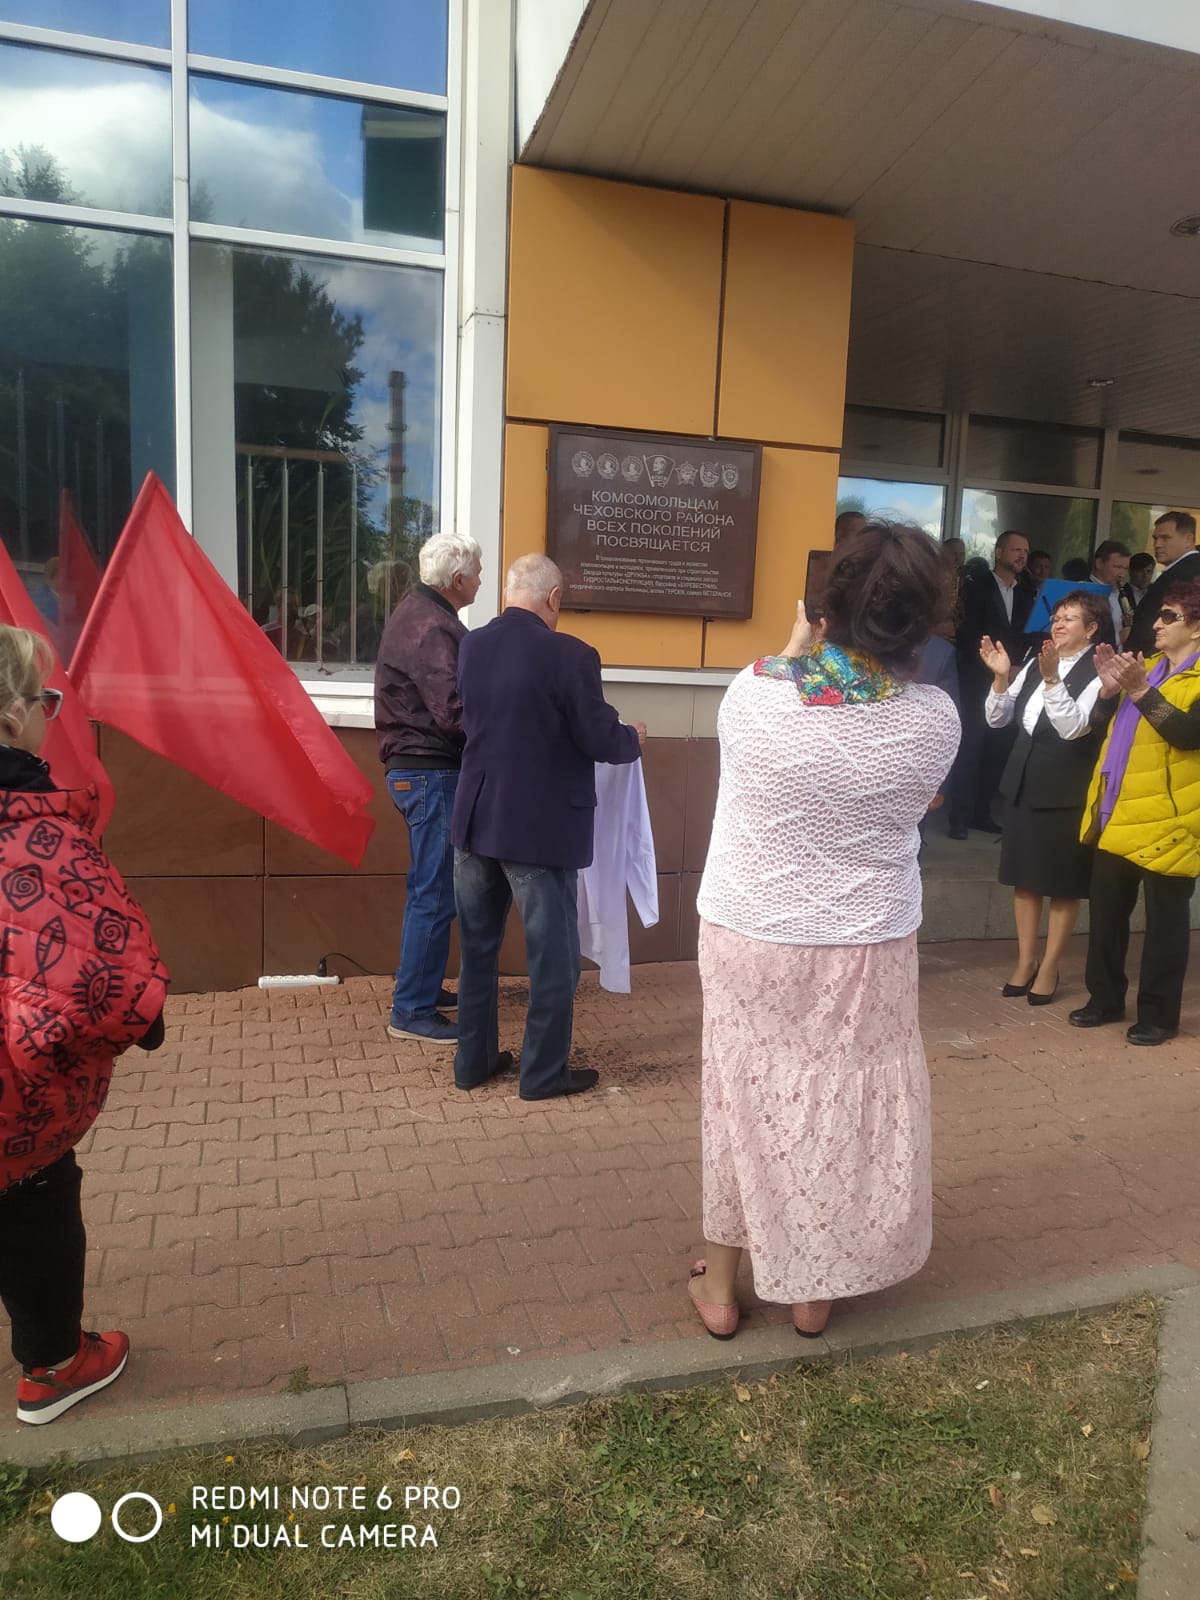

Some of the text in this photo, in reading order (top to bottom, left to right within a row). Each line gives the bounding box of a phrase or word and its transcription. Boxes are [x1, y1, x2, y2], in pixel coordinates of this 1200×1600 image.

[591, 490, 719, 511] КОМСОМОЛЬЦАМ
[573, 503, 735, 526] ЧЕХОВСКОГО РАЙОНА
[587, 519, 721, 539] ВСЕХ ПОКОЛЕНИЙ
[597, 534, 710, 552] ПОСВЯЩАЕТСЯ
